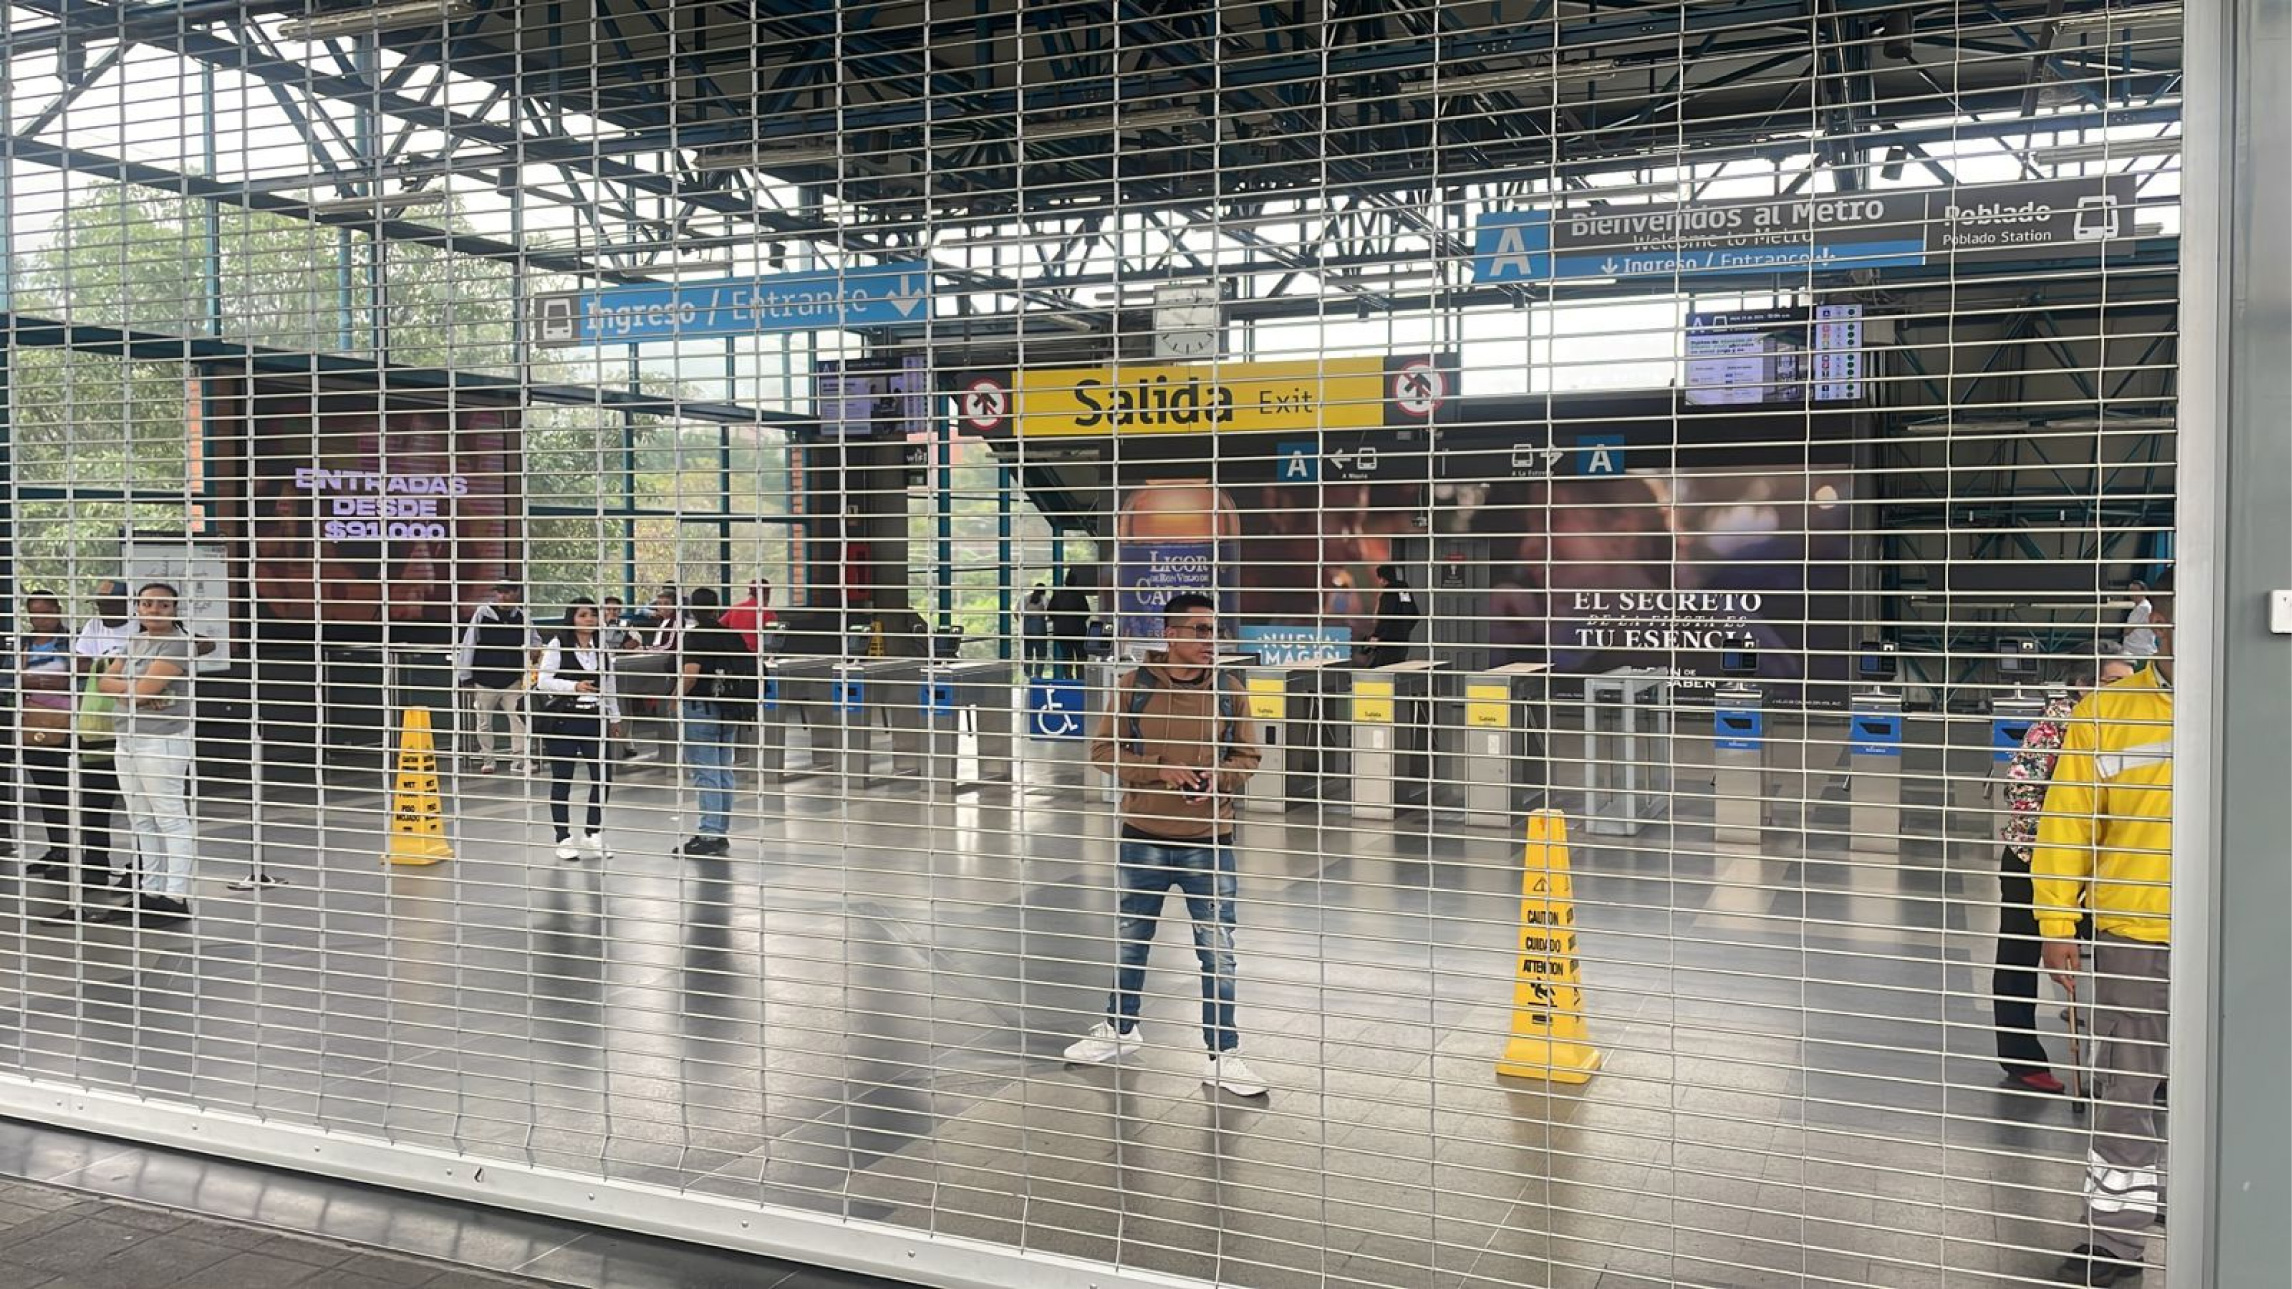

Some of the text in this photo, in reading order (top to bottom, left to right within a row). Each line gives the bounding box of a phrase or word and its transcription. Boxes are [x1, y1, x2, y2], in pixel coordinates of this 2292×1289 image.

[1571, 199, 1884, 236] Bienvenidos al Metro
[1944, 201, 2051, 227] Poblado
[1634, 227, 1814, 252] Welcome to Metro
[1942, 228, 2052, 246] Poblado Station
[1489, 227, 1532, 276] A
[1623, 256, 1697, 274] Ingreso
[1721, 251, 1810, 268] Entrance
[586, 301, 696, 335] Ingreso
[732, 287, 868, 321] Entrance
[1073, 375, 1313, 427] Salida Exit
[1287, 450, 1309, 478] A
[1589, 443, 1613, 473] A
[295, 467, 468, 495] ENTRADAS
[333, 498, 437, 518] DESDE
[325, 519, 445, 543] $91000
[1573, 592, 1762, 612] EL SECRETO
[1263, 632, 1336, 650] NUEVA
[1575, 629, 1616, 648] TU
[1258, 649, 1340, 665] IMAGEN
[1527, 910, 1559, 926] CAUTON
